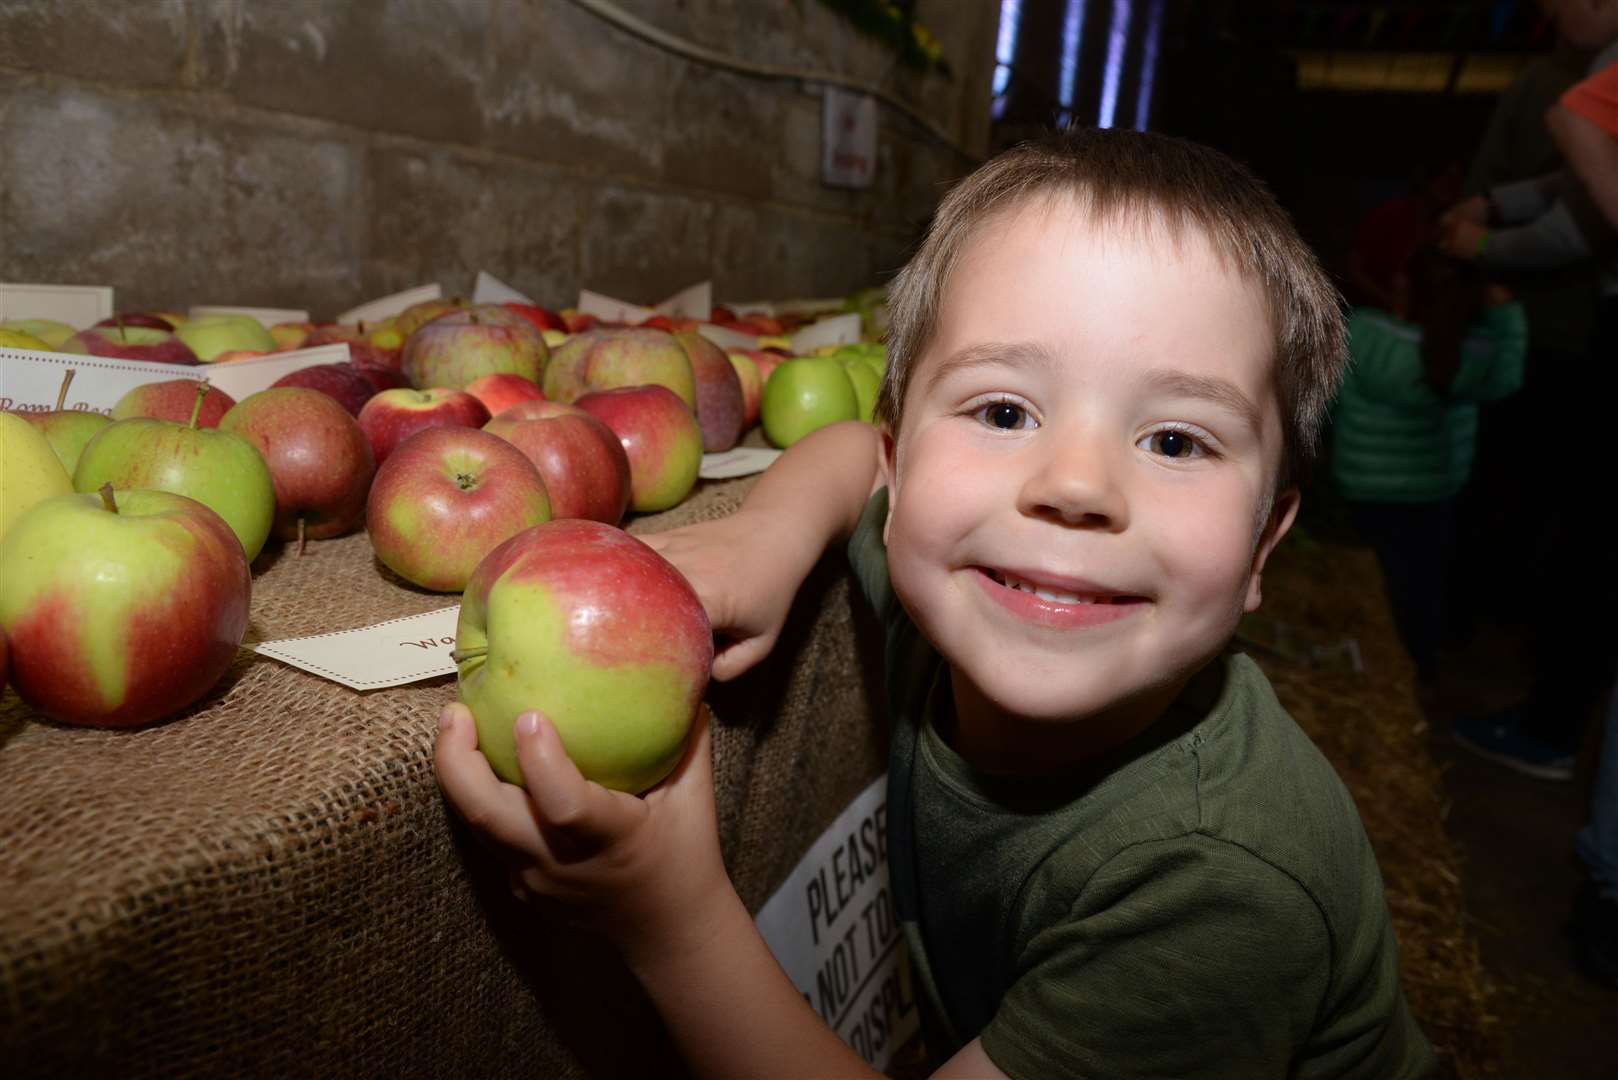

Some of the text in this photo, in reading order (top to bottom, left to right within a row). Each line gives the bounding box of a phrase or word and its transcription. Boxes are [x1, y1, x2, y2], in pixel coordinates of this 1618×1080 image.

[0, 397, 52, 413] Rom
[399, 636, 456, 650] Wa
[806, 803, 887, 945] PLEASE
[816, 887, 898, 1023] NOT TO
